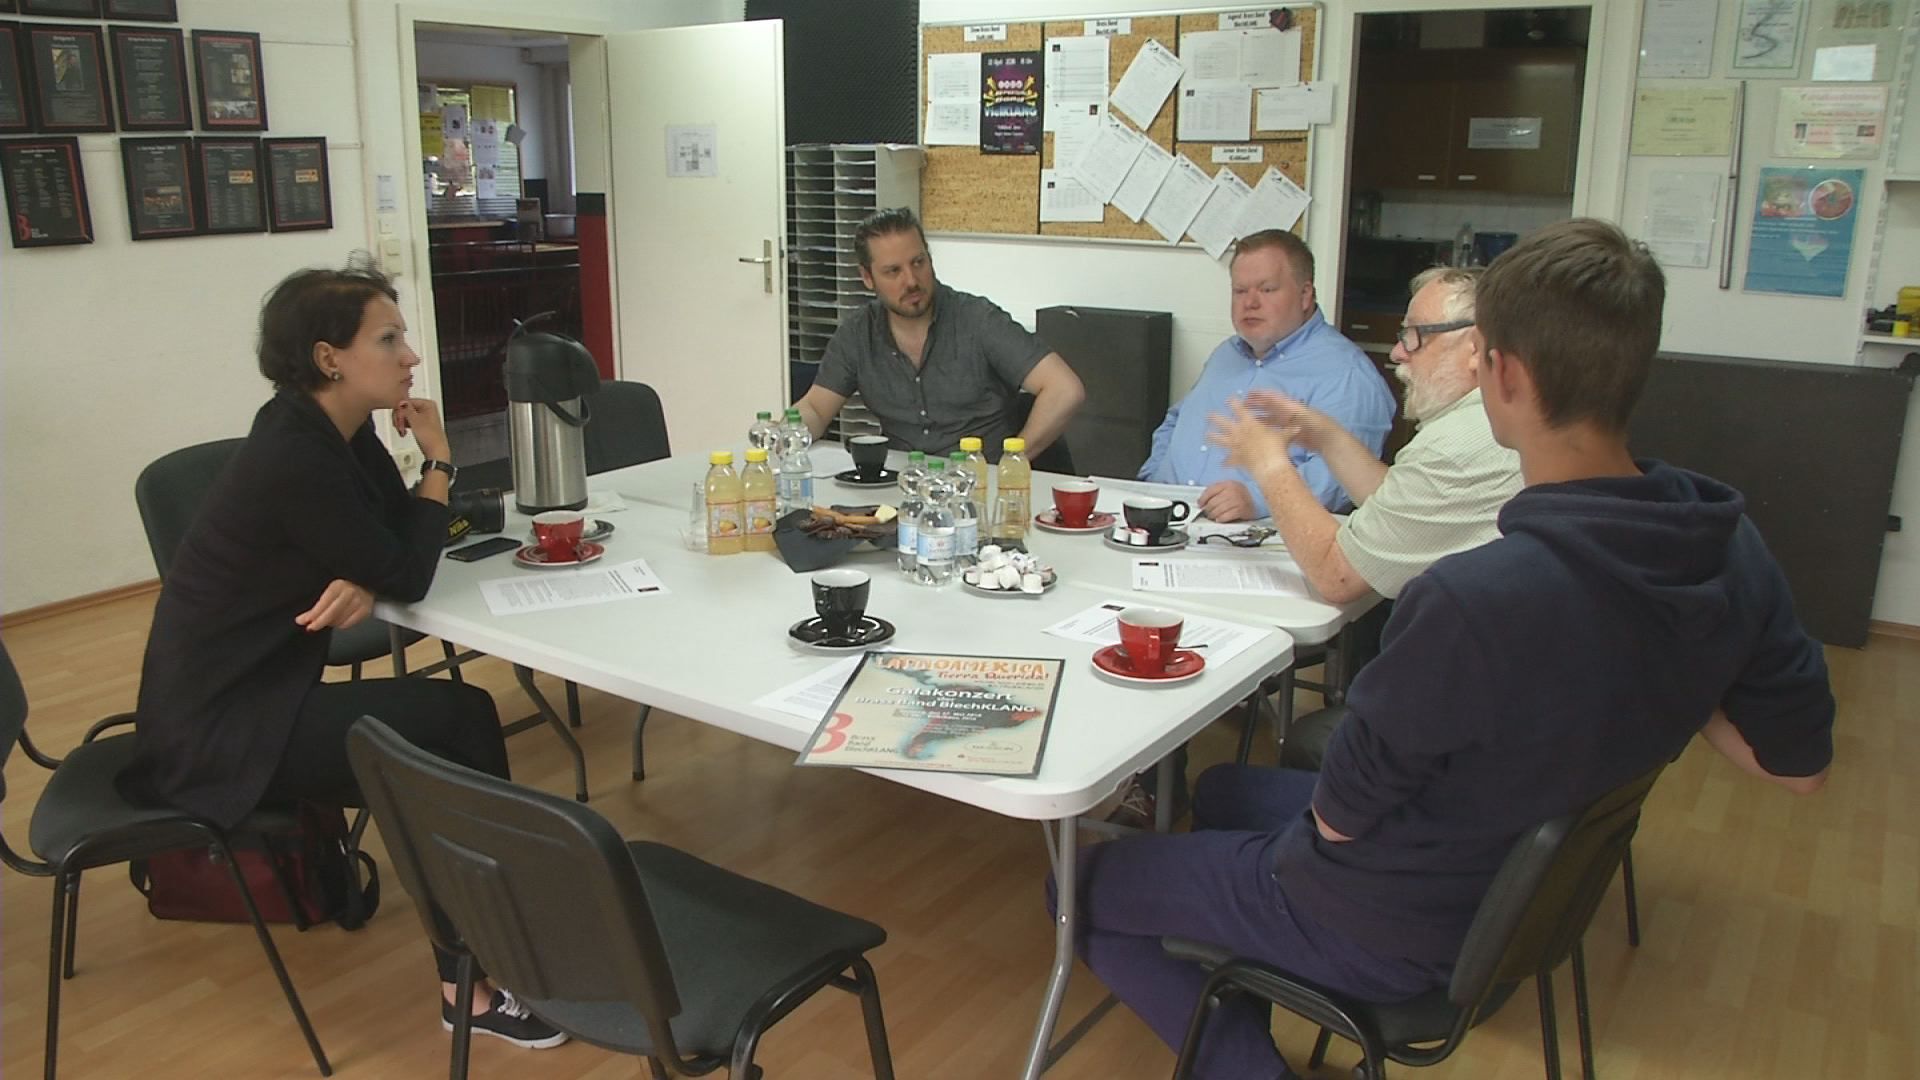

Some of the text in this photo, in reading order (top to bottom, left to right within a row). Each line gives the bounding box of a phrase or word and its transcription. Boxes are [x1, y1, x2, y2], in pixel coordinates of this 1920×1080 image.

[937, 671, 1049, 681] Tierra Querida!
[886, 686, 1013, 701] Galakonzert
[896, 698, 935, 708] Band
[939, 699, 1036, 713] BlechKLANG
